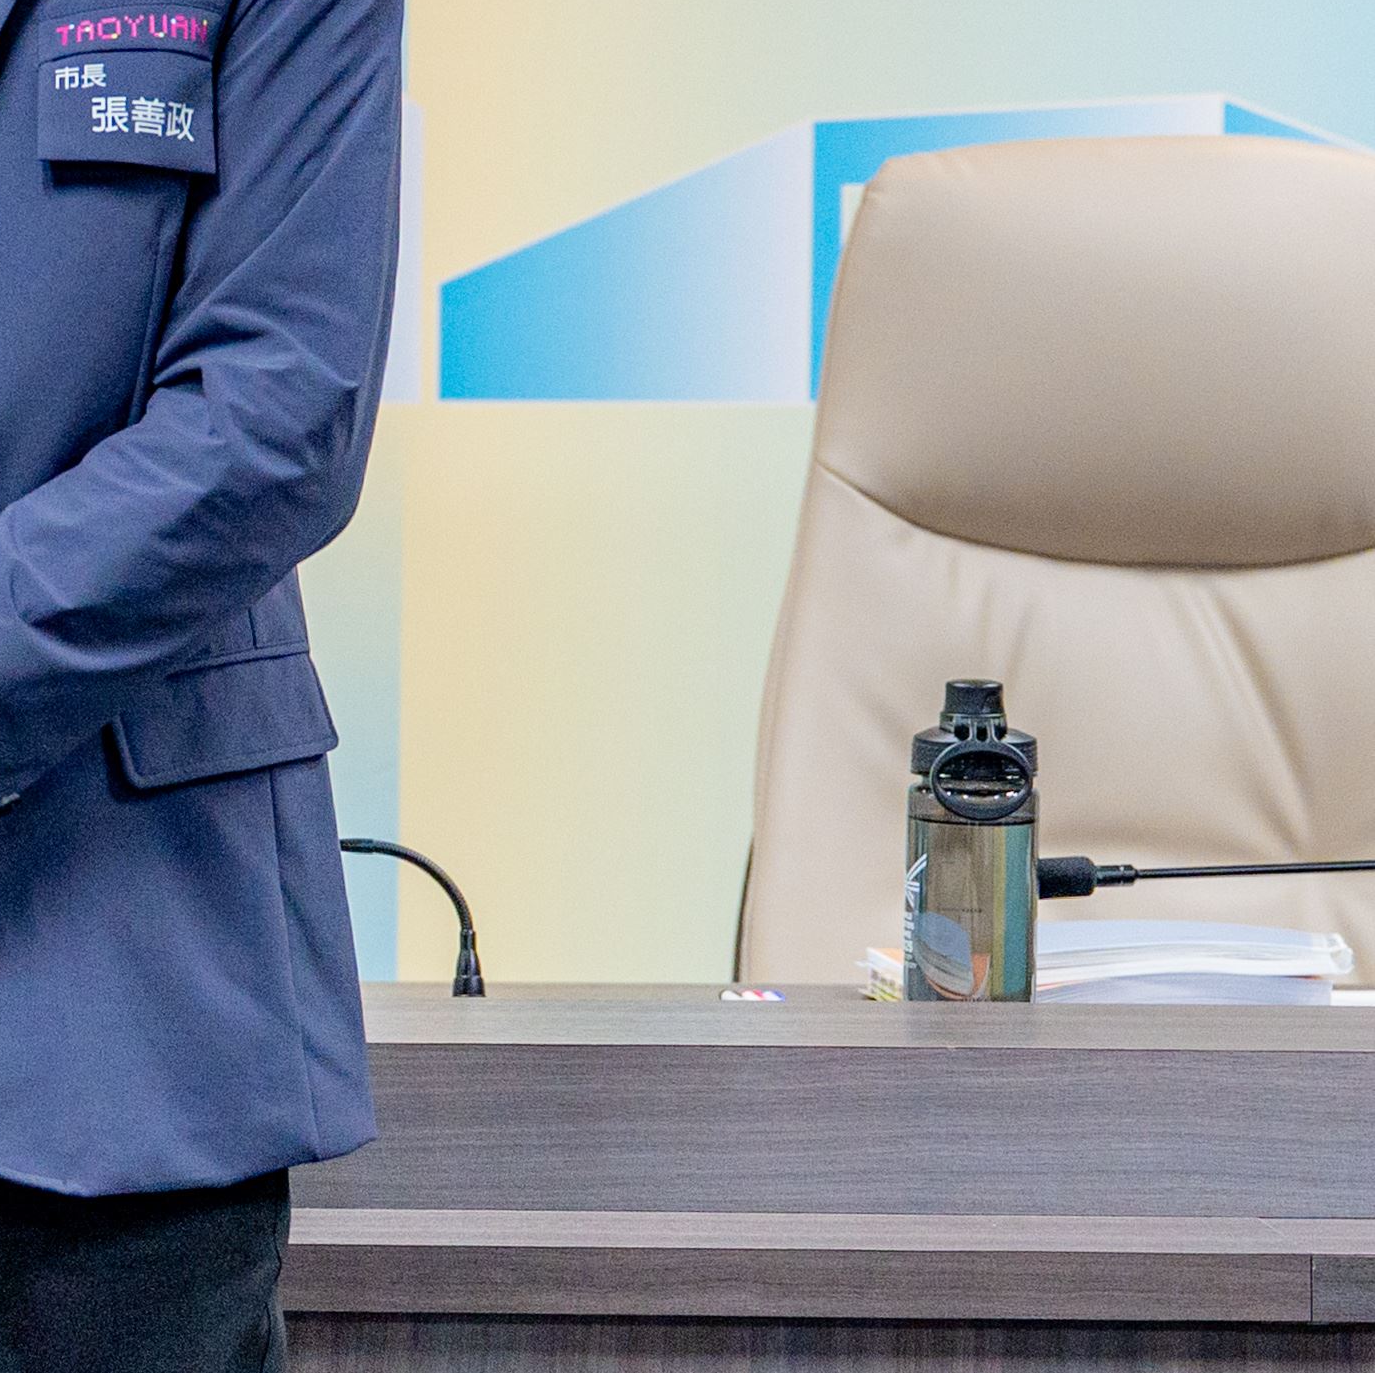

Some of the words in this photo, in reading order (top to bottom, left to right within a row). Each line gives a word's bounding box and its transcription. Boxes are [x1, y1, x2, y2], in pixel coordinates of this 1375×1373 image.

[56, 14, 208, 46] TAOYUAN
[55, 64, 106, 90] 市長
[91, 96, 195, 142] 張善政
